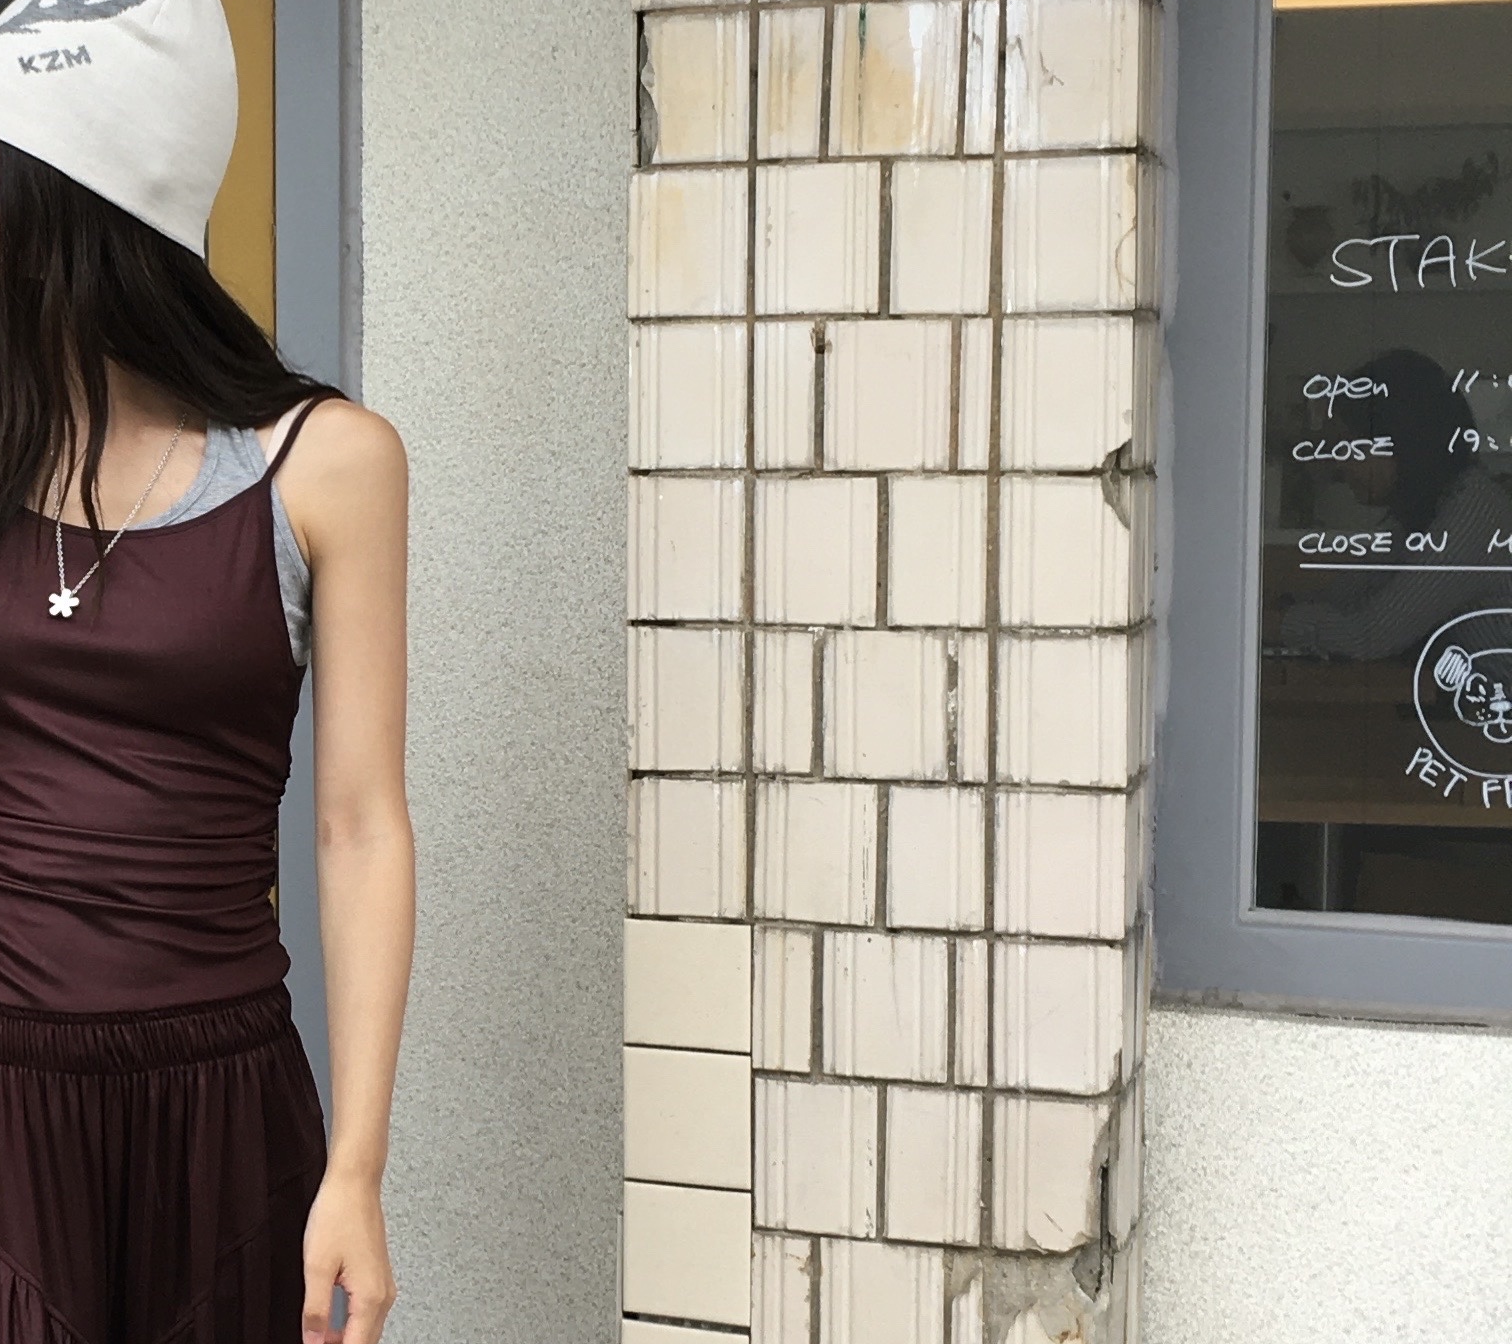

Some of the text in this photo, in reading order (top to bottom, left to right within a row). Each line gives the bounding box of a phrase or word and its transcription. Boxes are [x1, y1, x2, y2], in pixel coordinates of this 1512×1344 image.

[17, 44, 92, 74] KZM
[1330, 234, 1512, 292] STAK
[1451, 368, 1512, 393] 11:
[1292, 427, 1512, 461] CLOSE 19:
[1298, 532, 1393, 556] CLOSE
[1405, 530, 1448, 553] ON
[1405, 746, 1468, 798] PET
